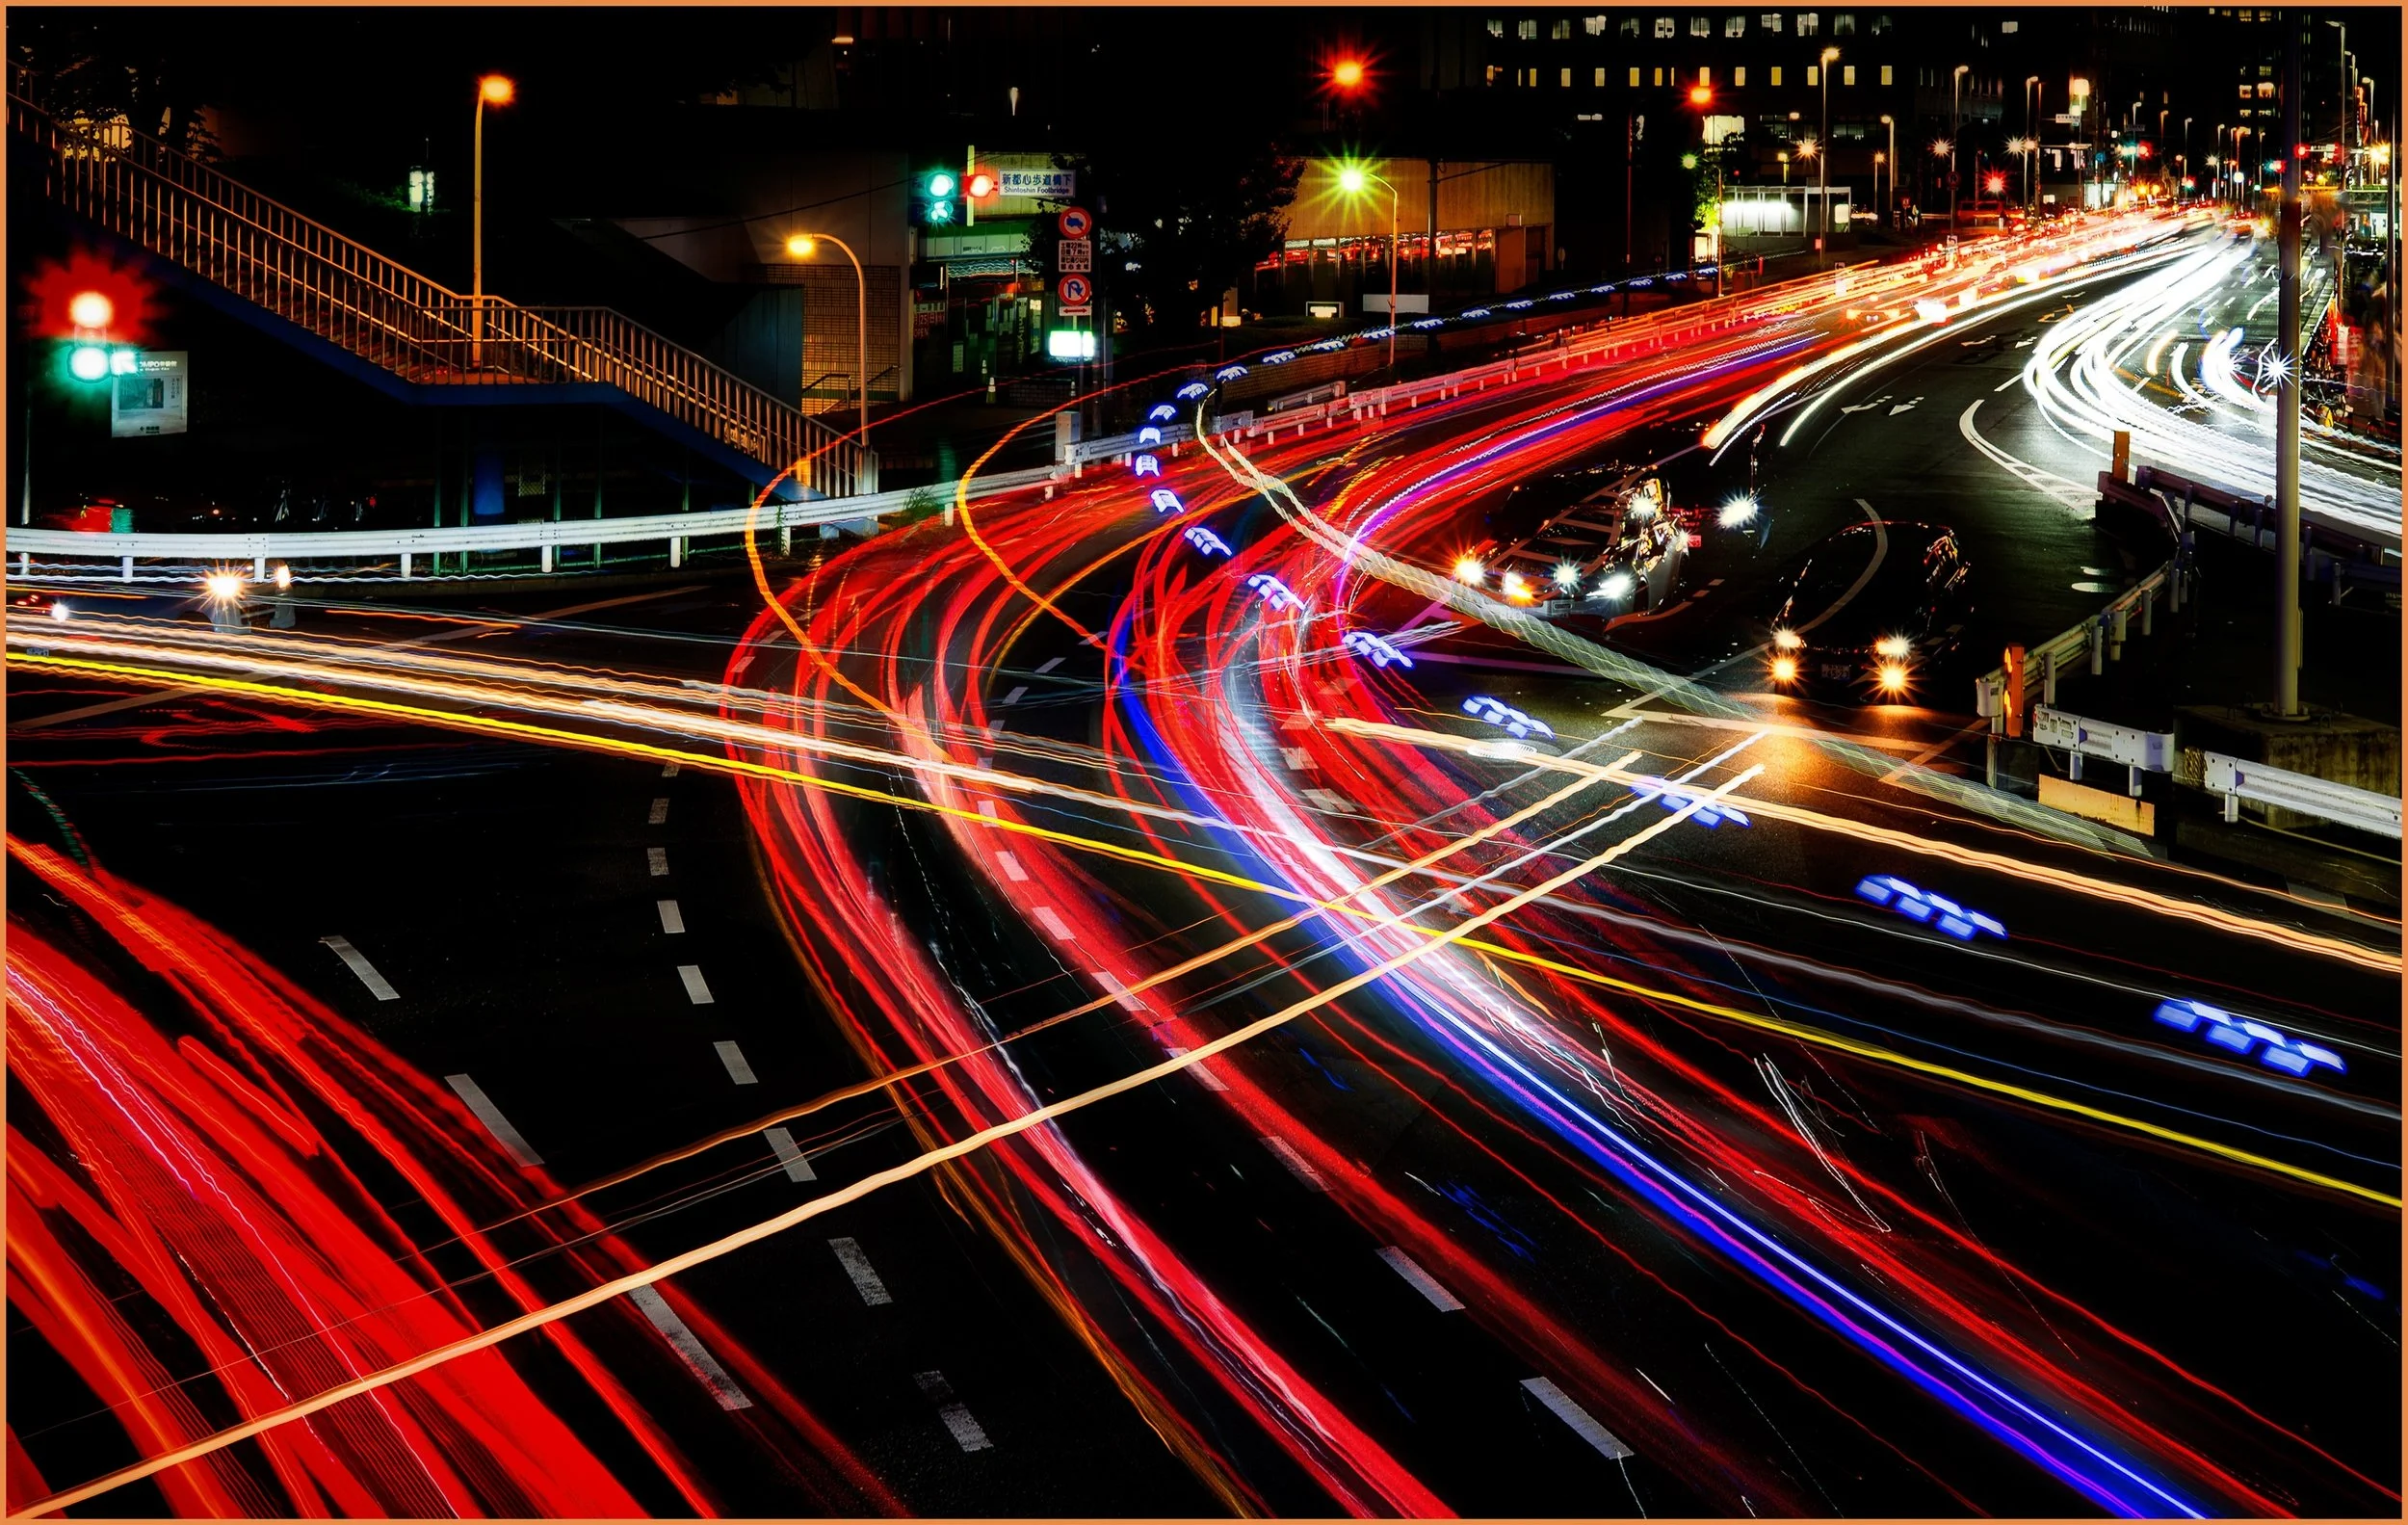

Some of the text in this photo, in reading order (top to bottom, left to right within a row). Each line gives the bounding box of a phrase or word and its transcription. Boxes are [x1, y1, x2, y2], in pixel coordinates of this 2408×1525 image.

[1003, 173, 1071, 185] 新都心歩道橋下
